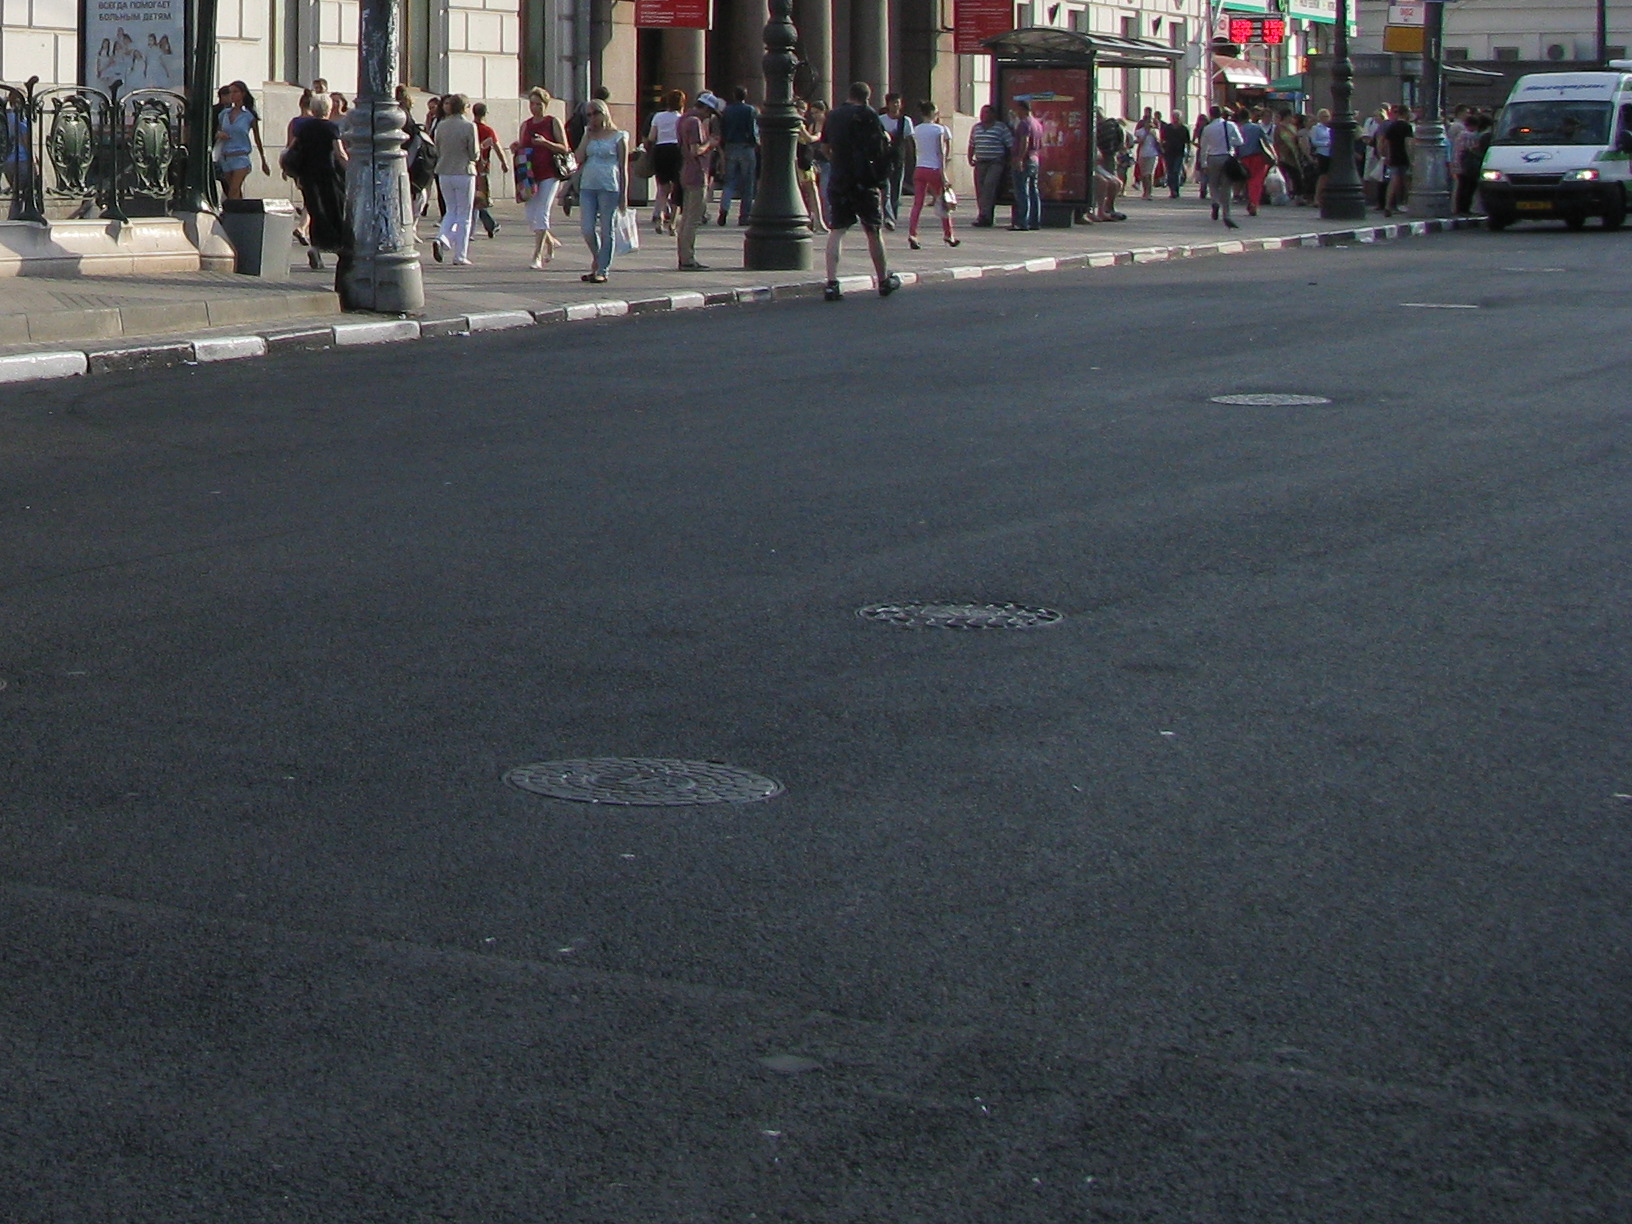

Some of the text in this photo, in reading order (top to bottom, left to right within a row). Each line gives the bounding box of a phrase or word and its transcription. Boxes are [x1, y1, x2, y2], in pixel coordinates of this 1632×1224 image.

[98, 0, 171, 11] ВСЕГДА ПОМОГАЕТ
[98, 12, 172, 22] БОЛЬНЫМ ДЕТЯМ
